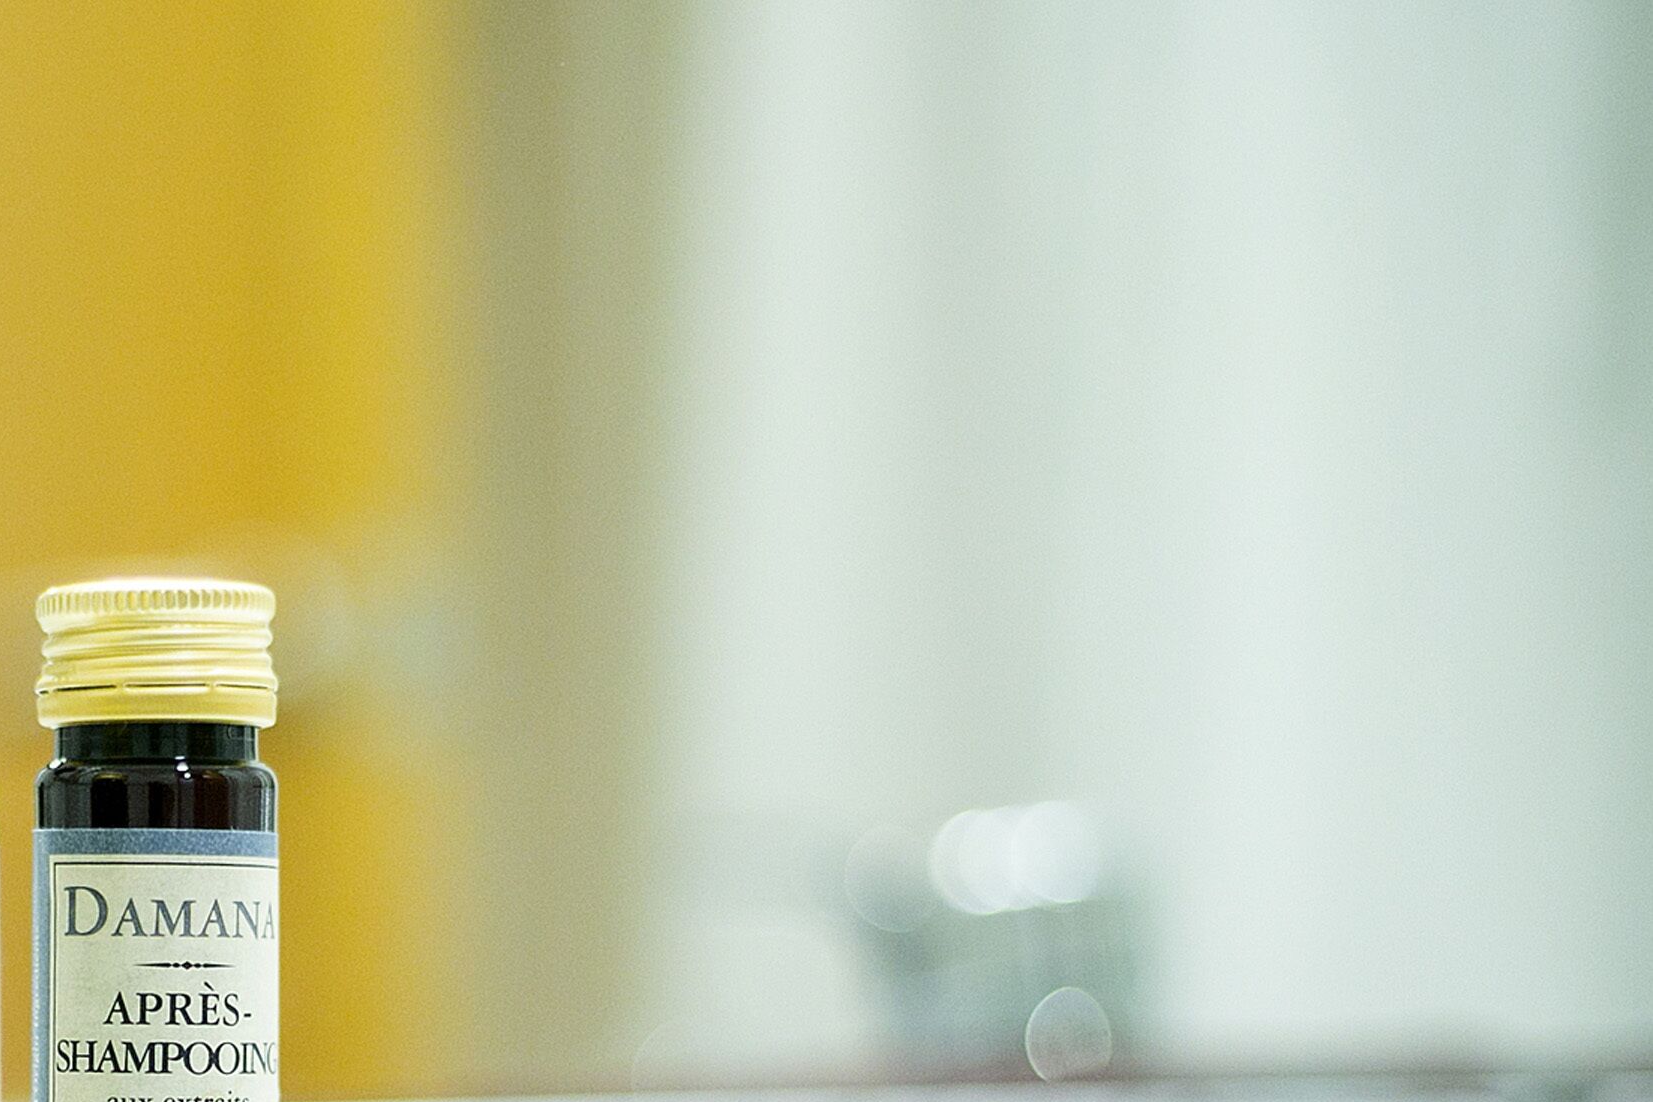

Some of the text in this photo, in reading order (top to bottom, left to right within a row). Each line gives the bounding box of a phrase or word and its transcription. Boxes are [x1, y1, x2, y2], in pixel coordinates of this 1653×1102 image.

[63, 886, 276, 939] DAMANA
[103, 981, 252, 1027] APRÈS-
[55, 1038, 277, 1075] SHAMPOOING
